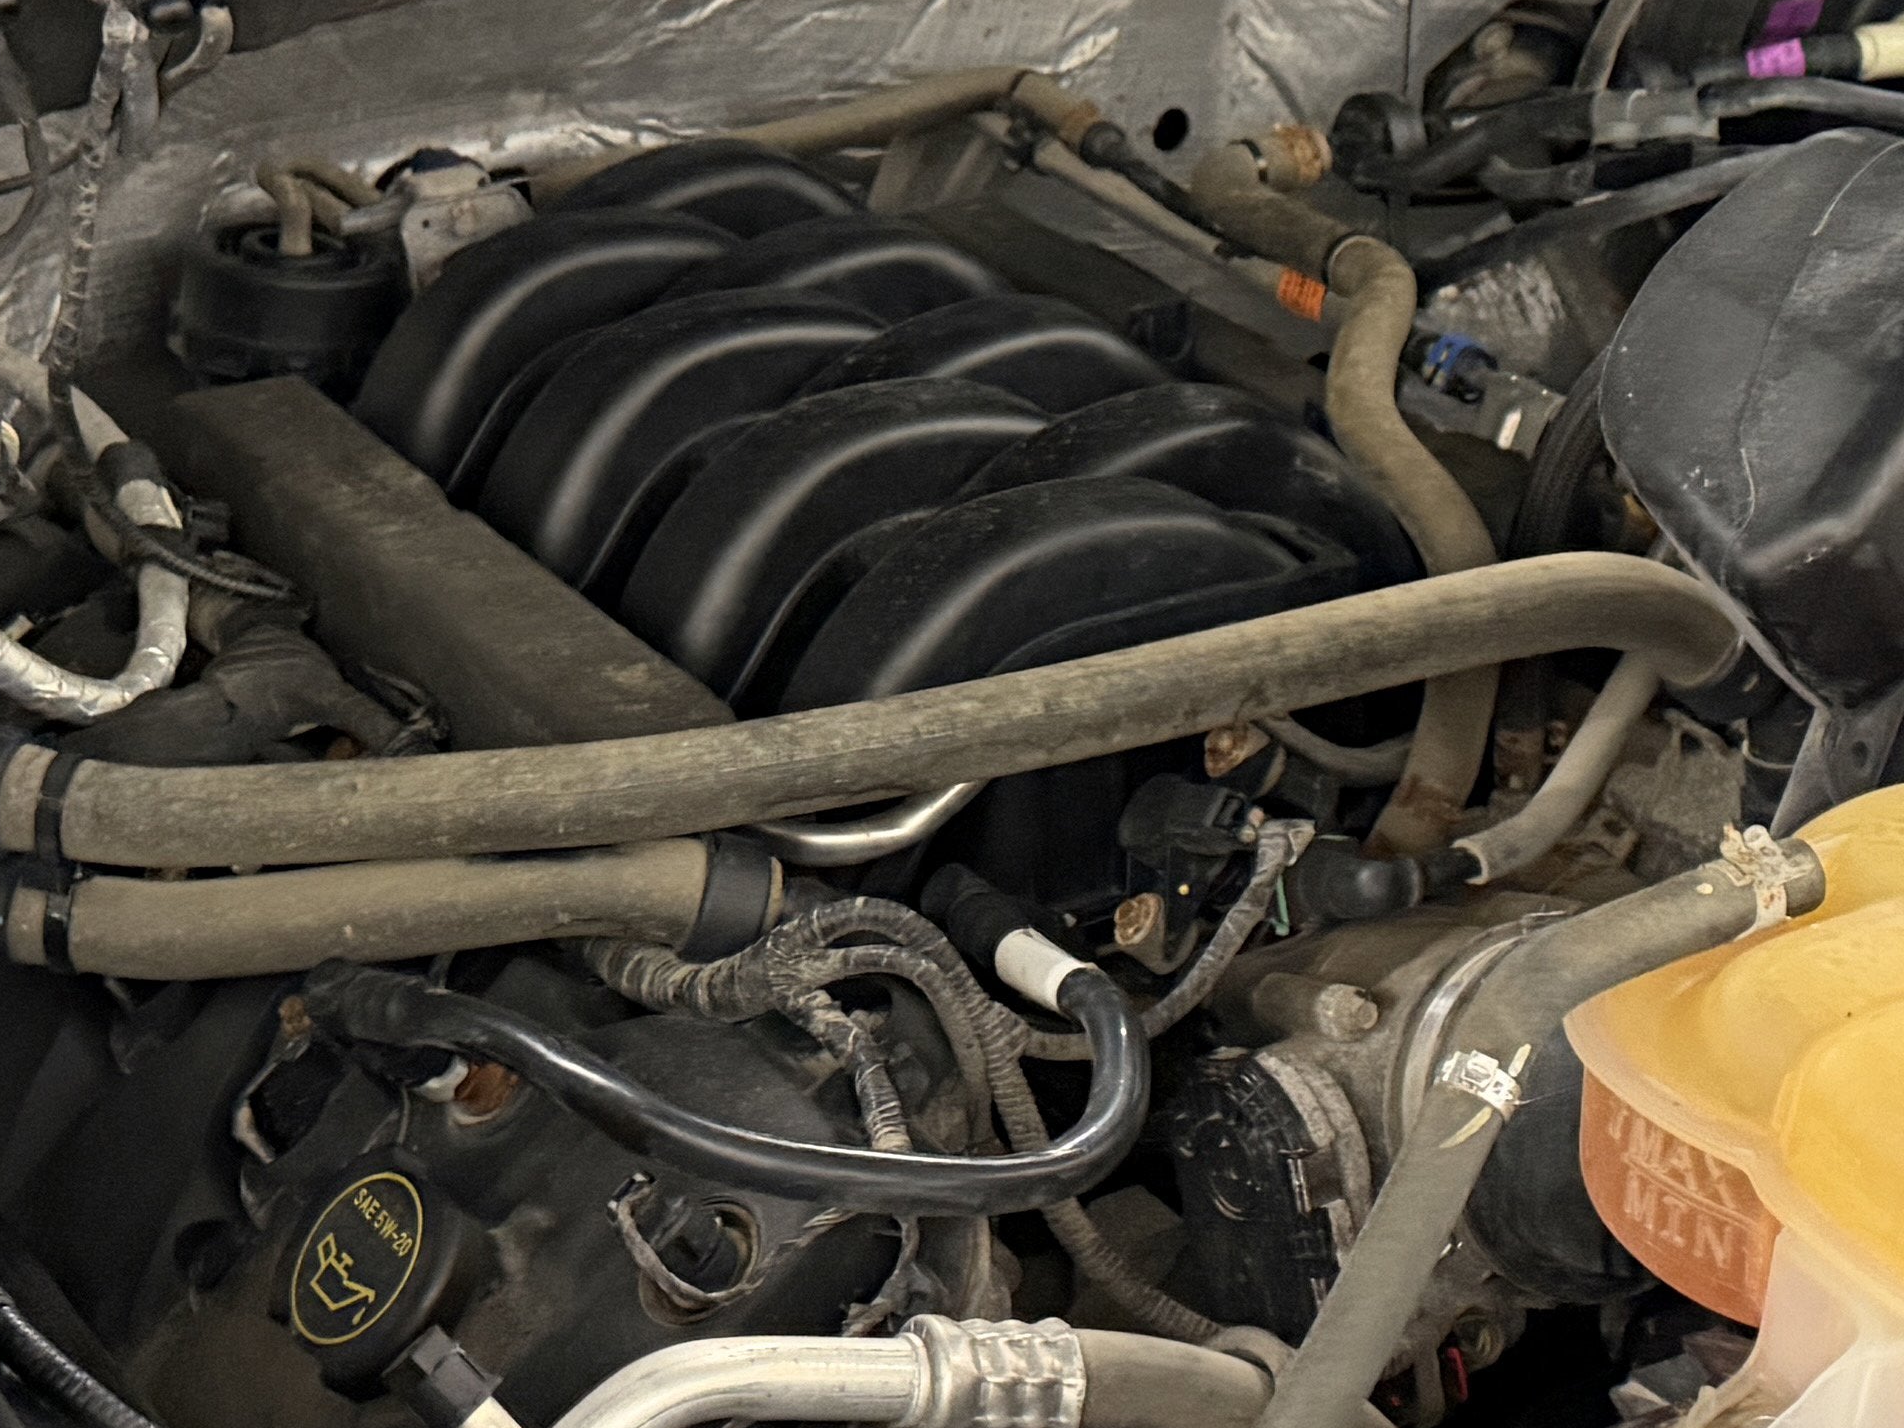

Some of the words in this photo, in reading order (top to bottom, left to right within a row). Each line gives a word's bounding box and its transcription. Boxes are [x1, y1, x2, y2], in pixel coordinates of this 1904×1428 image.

[1629, 1117, 1737, 1209] MAX
[351, 1187, 379, 1221] SAE
[373, 1214, 413, 1257] 5W-20
[1623, 1172, 1735, 1270] MIN
